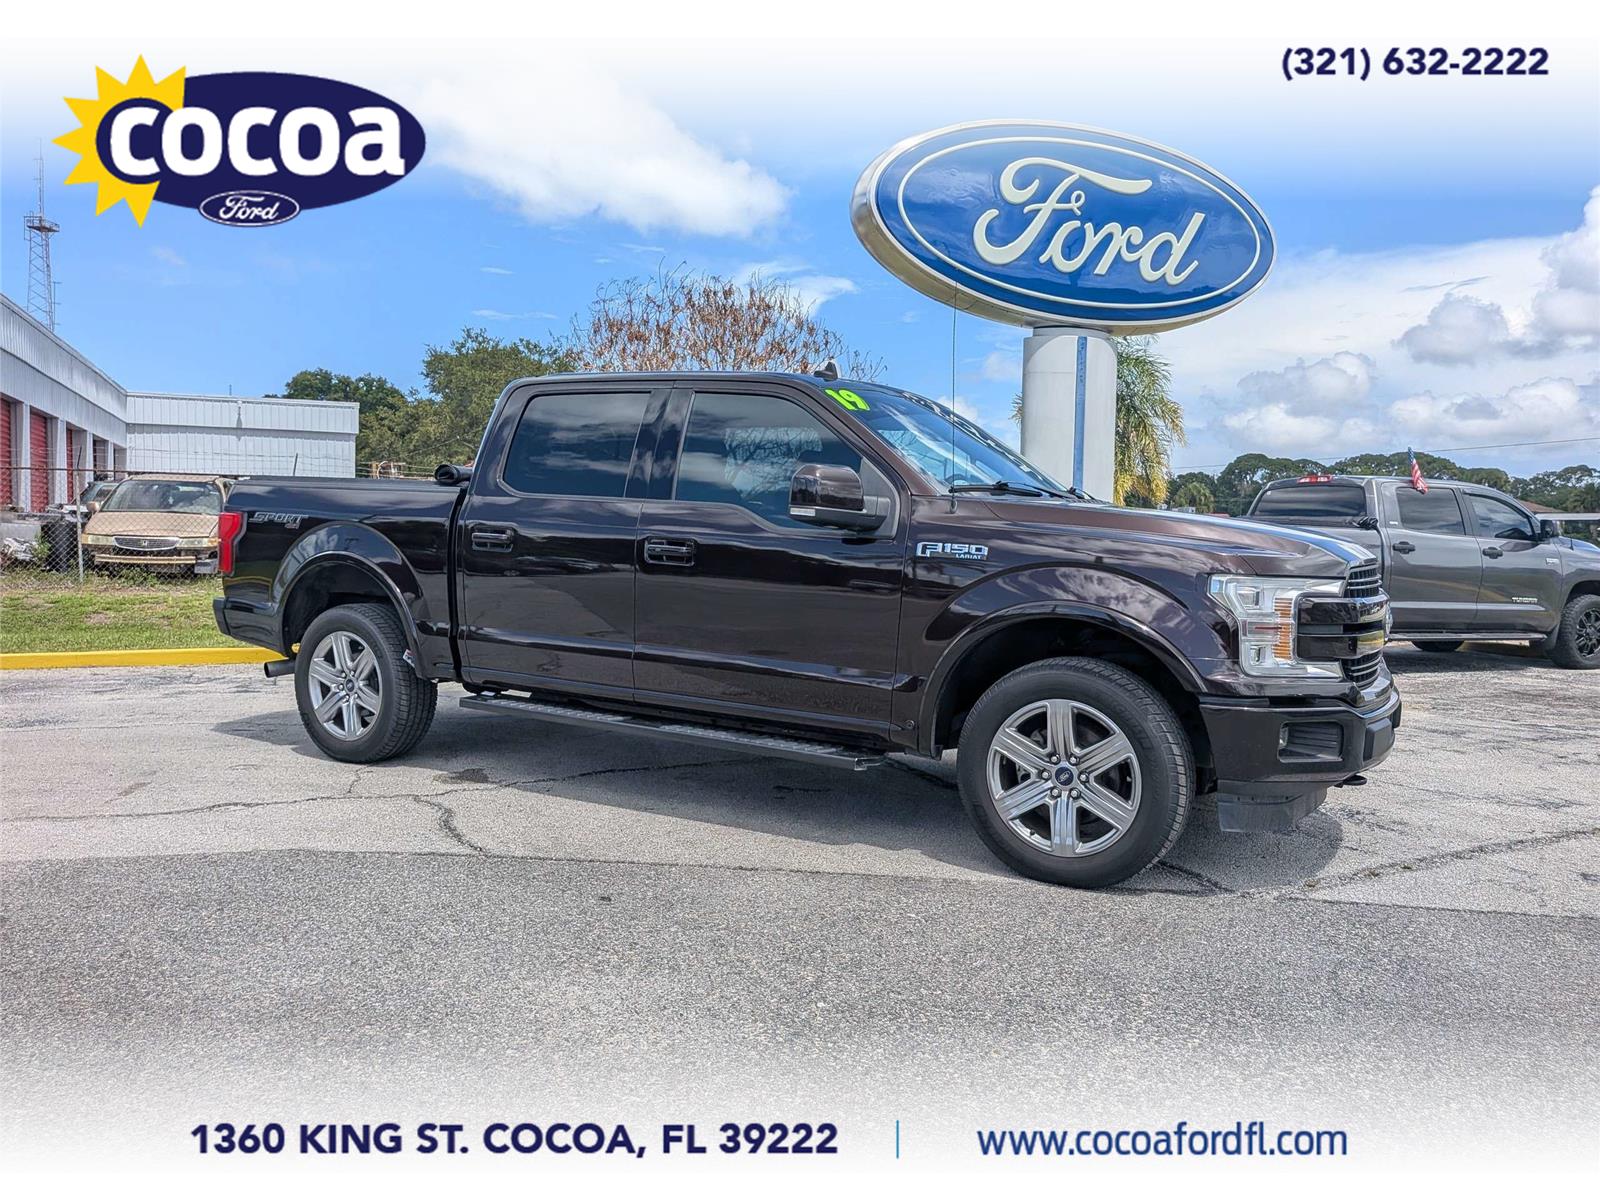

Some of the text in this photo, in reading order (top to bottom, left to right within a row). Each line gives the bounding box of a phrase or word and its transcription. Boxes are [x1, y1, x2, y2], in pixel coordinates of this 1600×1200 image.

[973, 157, 1205, 285] Ford
[824, 389, 870, 410] 19
[248, 512, 309, 524] SPORT
